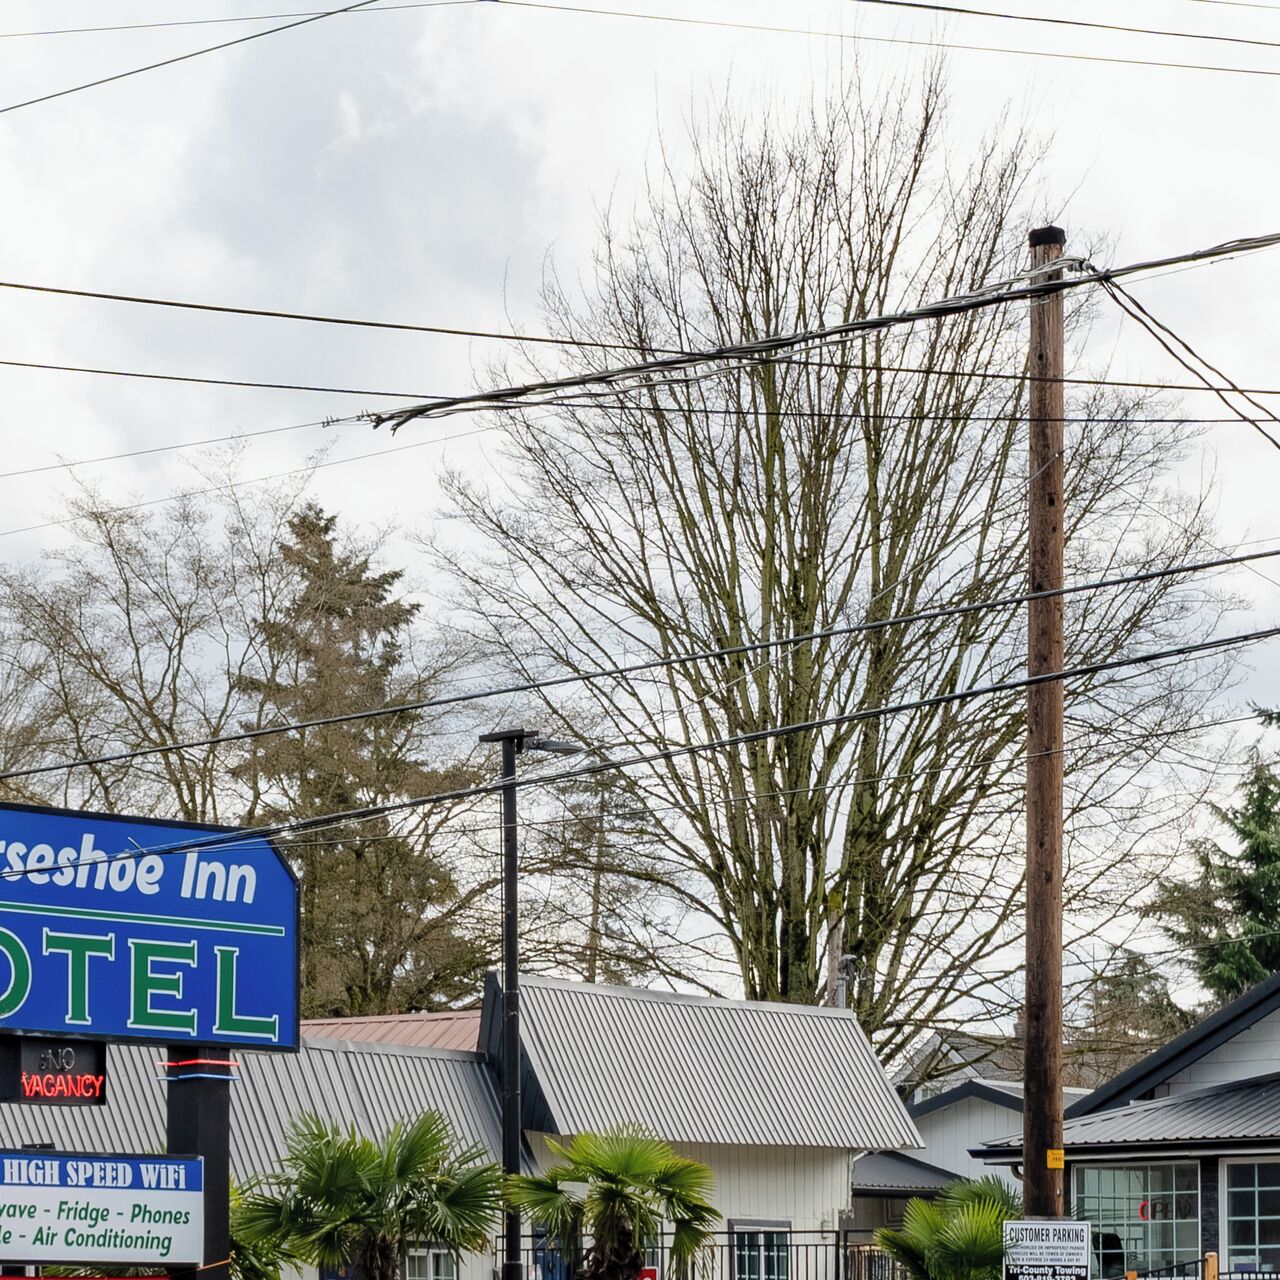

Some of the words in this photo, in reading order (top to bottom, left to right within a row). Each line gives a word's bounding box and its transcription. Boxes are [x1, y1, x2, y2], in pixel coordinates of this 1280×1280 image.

[180, 849, 257, 904] Inn
[46, 1047, 75, 1071] NO
[21, 1073, 104, 1097] VACANCY
[3, 1159, 60, 1185] HIGH
[66, 1161, 133, 1188] SPEED
[139, 1163, 186, 1190] WiFi
[57, 1201, 110, 1228] Fridge
[130, 1204, 190, 1225] Phones
[32, 1226, 58, 1246] Air
[64, 1228, 172, 1257] Conditioning
[1009, 1227, 1050, 1243] CUSTOMER
[1052, 1228, 1084, 1243] PARKING
[1008, 1265, 1053, 1275] Tri-County
[1055, 1266, 1086, 1276] Towing
